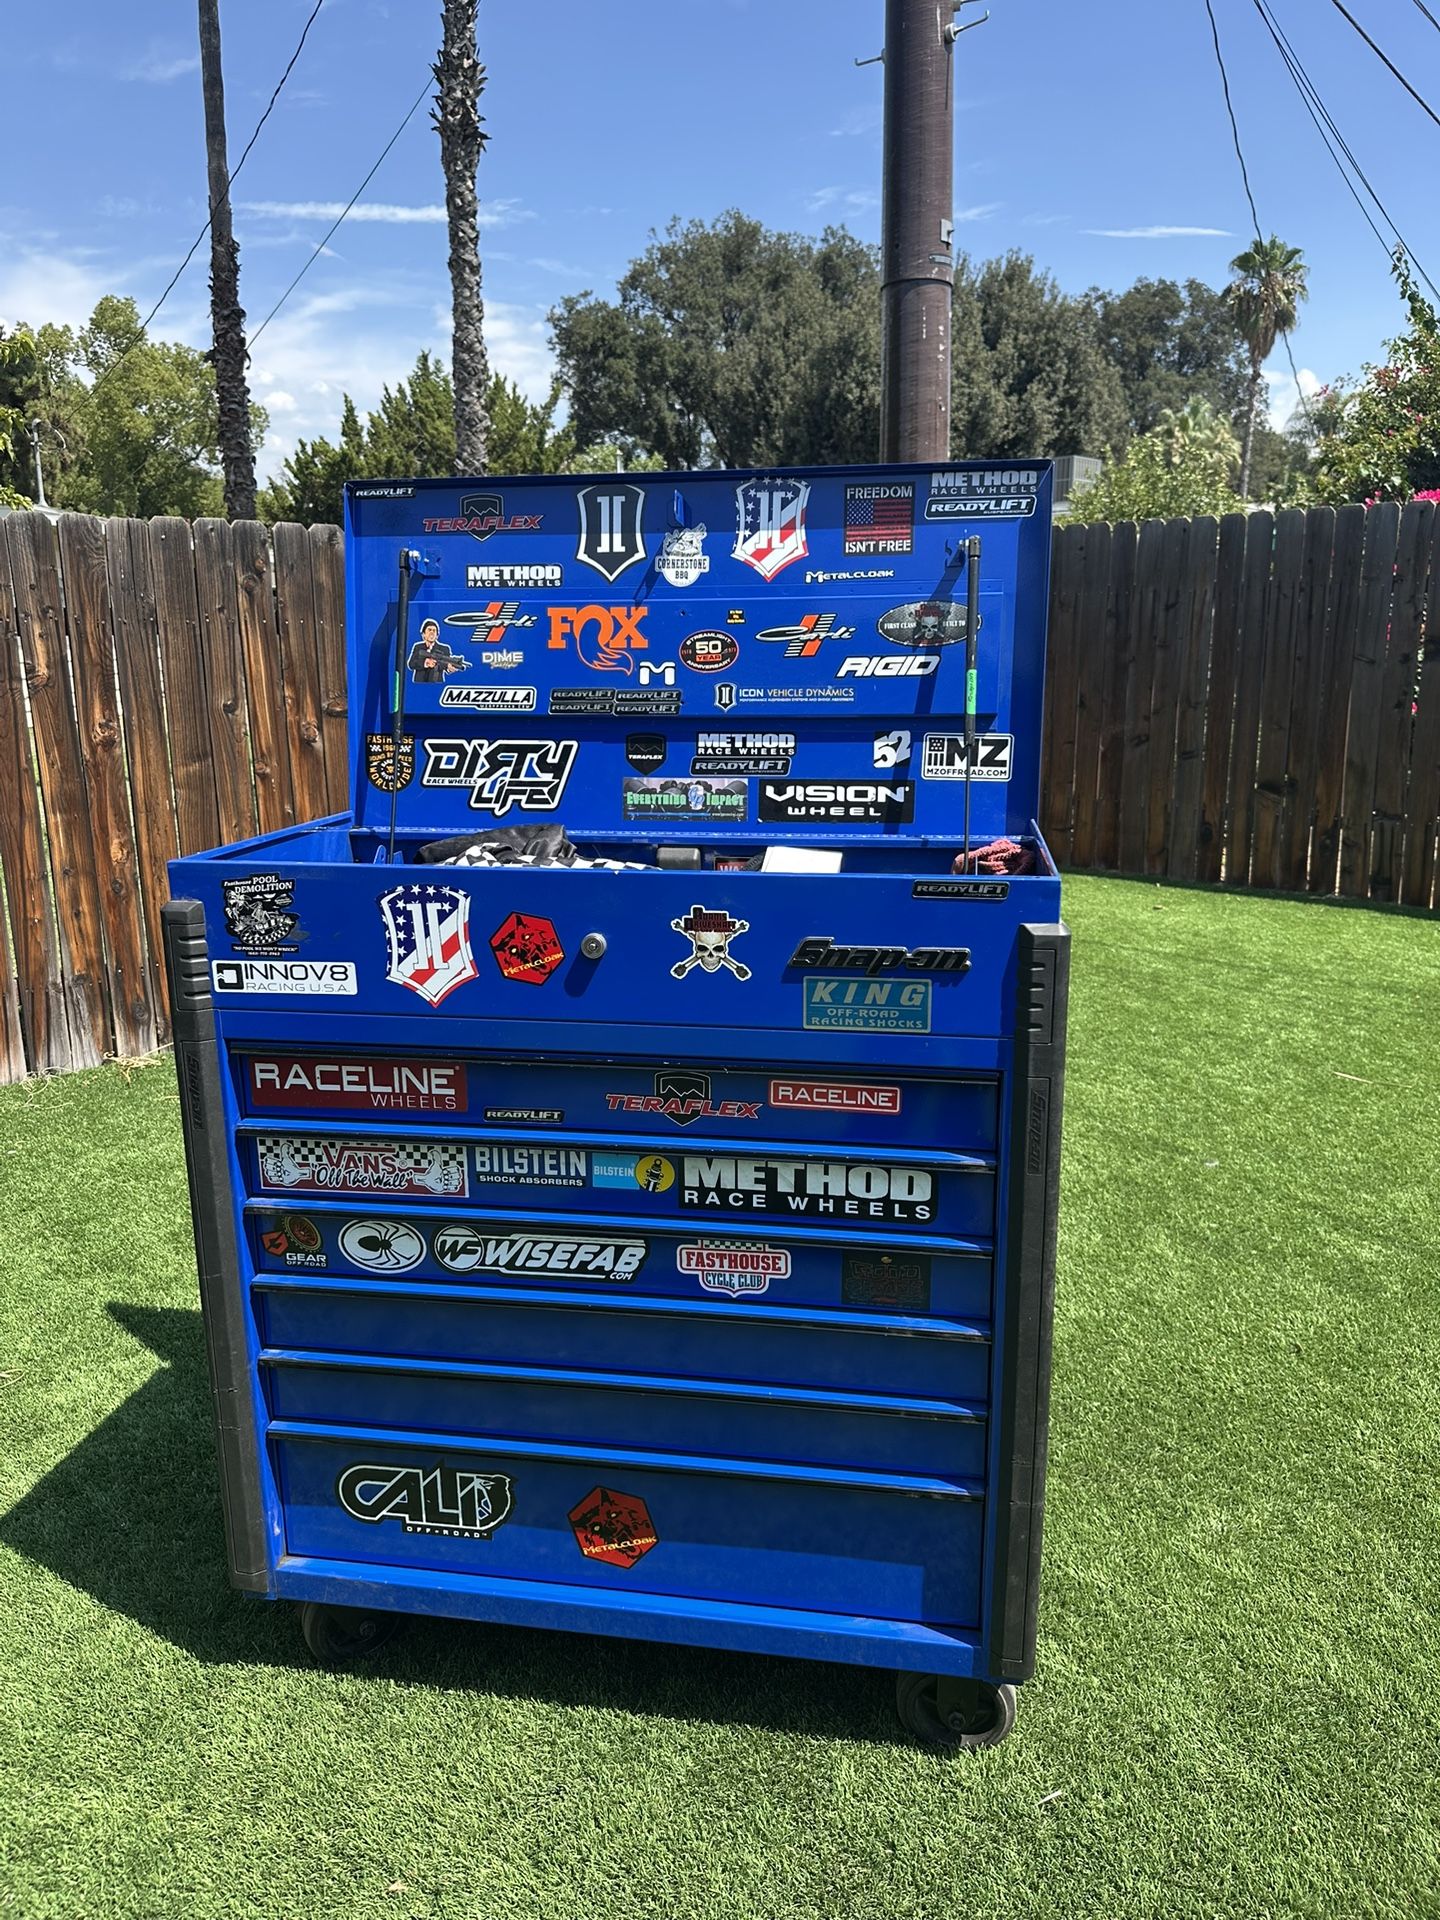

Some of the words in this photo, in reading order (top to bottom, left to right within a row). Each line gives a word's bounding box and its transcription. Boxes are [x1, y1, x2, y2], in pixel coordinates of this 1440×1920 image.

[932, 471, 1038, 486] METHOD
[356, 487, 414, 497] READYLIFT
[846, 486, 913, 500] FREEDOM
[931, 486, 967, 495] RACE
[976, 485, 1038, 494] WHEELS
[931, 499, 1031, 513] READYLIFT
[423, 514, 544, 533] TERAFLEX
[845, 540, 876, 554] ISN'T
[878, 539, 911, 552] FREE
[657, 557, 708, 571] CORNERSTONE
[467, 565, 561, 580] METHOD
[675, 571, 689, 580] BBQ
[506, 579, 561, 587] WHEELS
[547, 604, 649, 662] FOX
[695, 641, 722, 654] 50
[482, 651, 524, 663] DIME
[686, 658, 732, 670] ANNIVERSARY
[836, 656, 941, 677] RIGID
[445, 690, 532, 703] MAZZULLA
[553, 689, 612, 698] READYLIFT
[618, 691, 678, 700] READYLIFT
[739, 688, 764, 697] ICON
[767, 688, 803, 697] VEHICLE
[806, 687, 854, 697] DYNAMICS
[551, 703, 611, 711] READYLIFT
[616, 704, 677, 713] READYLIFT
[367, 736, 414, 744] FASTHSE
[698, 733, 795, 748] METHOD
[873, 730, 911, 768] 52
[945, 738, 1009, 767] MZ
[427, 742, 575, 780] DIRTY
[695, 760, 787, 770] READYLIFT
[626, 791, 687, 806] EVERYTHING
[706, 792, 745, 806] IMPACT
[765, 785, 905, 803] VISION
[787, 806, 882, 816] WHEEL
[252, 876, 278, 885] POOL
[234, 882, 293, 894] DEMOLITION
[916, 884, 1006, 895] READYLIFT
[789, 936, 972, 975] Snap-on
[244, 963, 349, 981] INNOV8
[246, 983, 305, 992] RACING
[812, 981, 926, 1006] KING
[827, 1009, 899, 1018] OFF-ROAD
[812, 1017, 863, 1026] RACING
[869, 1019, 923, 1028] SHOCKS
[254, 1063, 456, 1095] RACELINE
[371, 1093, 456, 1109] WHEELS
[778, 1086, 893, 1107] RACELINE
[605, 1093, 765, 1119] TERAFLEX
[487, 1109, 561, 1120] READYLIFT
[322, 1144, 396, 1174] VANS
[475, 1147, 586, 1177] BILSTEIN
[346, 1168, 369, 1187] The
[594, 1165, 634, 1177] BILSTEIN
[479, 1175, 516, 1183] SHOCK
[519, 1176, 583, 1187] ABSORBERS
[684, 1156, 932, 1203] METHOD
[684, 1190, 767, 1209] RACE
[788, 1196, 931, 1219] WHEELS
[286, 1253, 327, 1263] GEAR
[484, 1239, 646, 1272] WISEFAB
[686, 1251, 782, 1272] FASTHOUSE
[609, 1271, 633, 1281] COM
[706, 1272, 736, 1289] CYCLE
[738, 1274, 763, 1288] CLUB
[339, 1465, 482, 1530] CALI
[406, 1525, 482, 1538] OFF-ROAD
